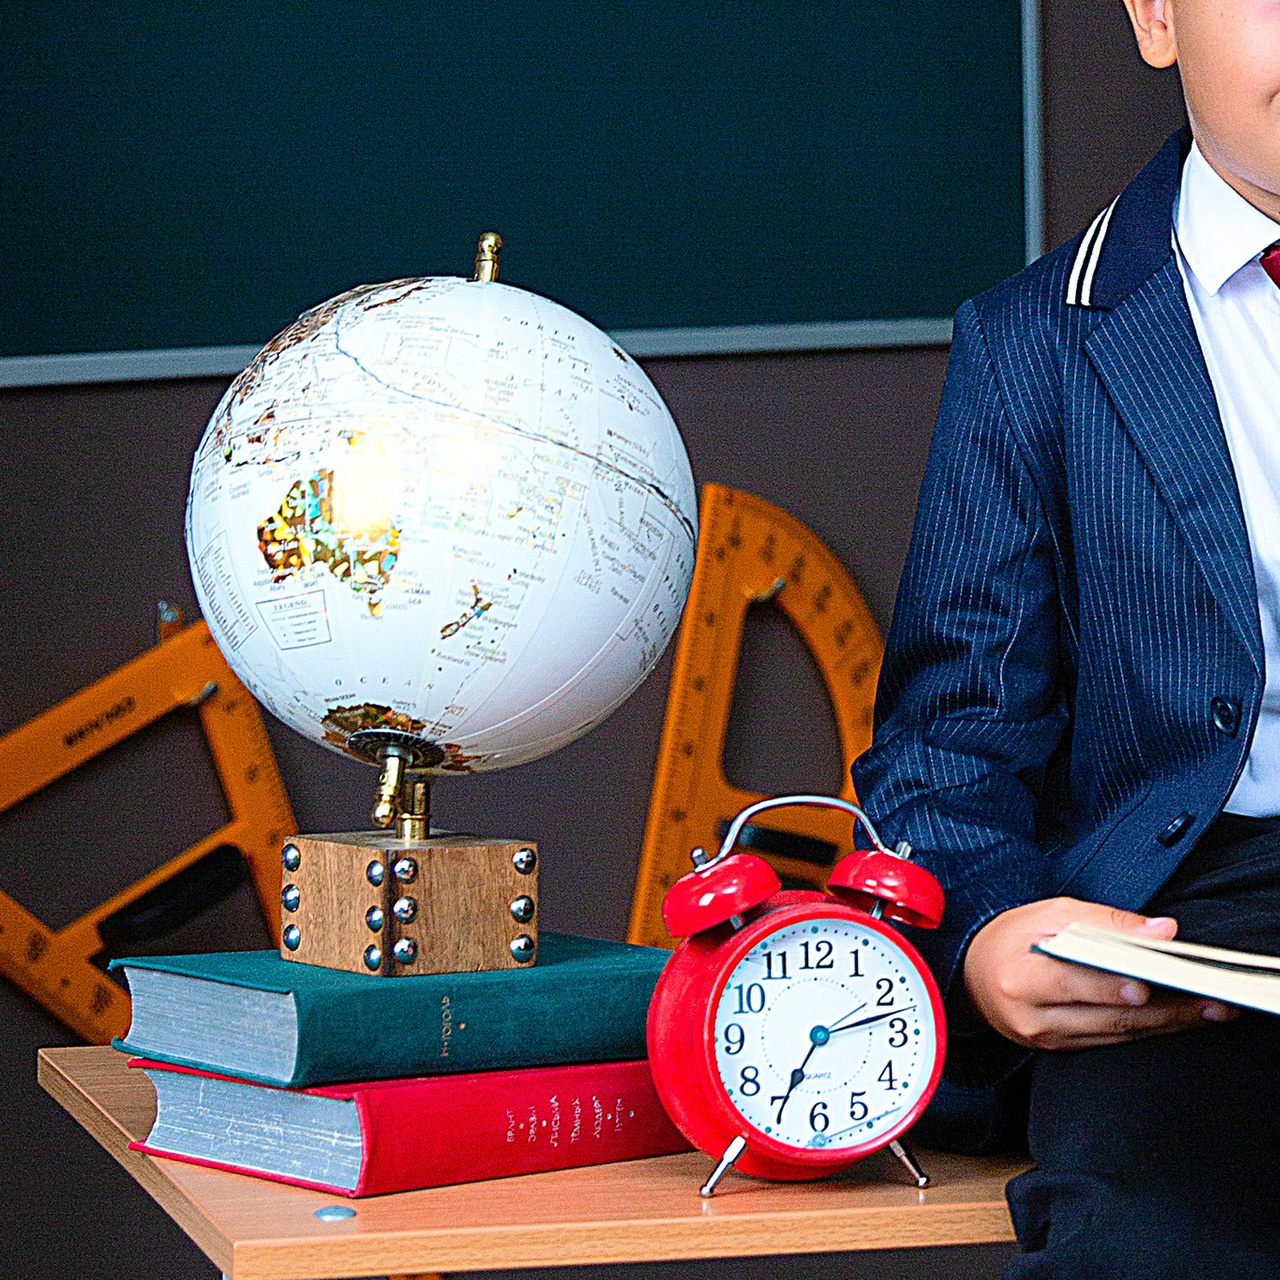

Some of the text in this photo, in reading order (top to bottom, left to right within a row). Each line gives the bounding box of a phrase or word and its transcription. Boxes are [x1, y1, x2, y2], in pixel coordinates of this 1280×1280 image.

[273, 599, 308, 611] LEGEND
[761, 950, 791, 980] 11
[799, 940, 834, 970] 12
[849, 949, 864, 977] 1
[733, 982, 765, 1015] 10
[876, 978, 894, 1006] 2
[724, 1023, 745, 1055] 9
[888, 1018, 908, 1047] 3
[740, 1065, 760, 1096] 8
[877, 1060, 897, 1090] 4
[770, 1095, 790, 1124] 7
[809, 1102, 829, 1133] 6
[849, 1091, 868, 1120] 5
